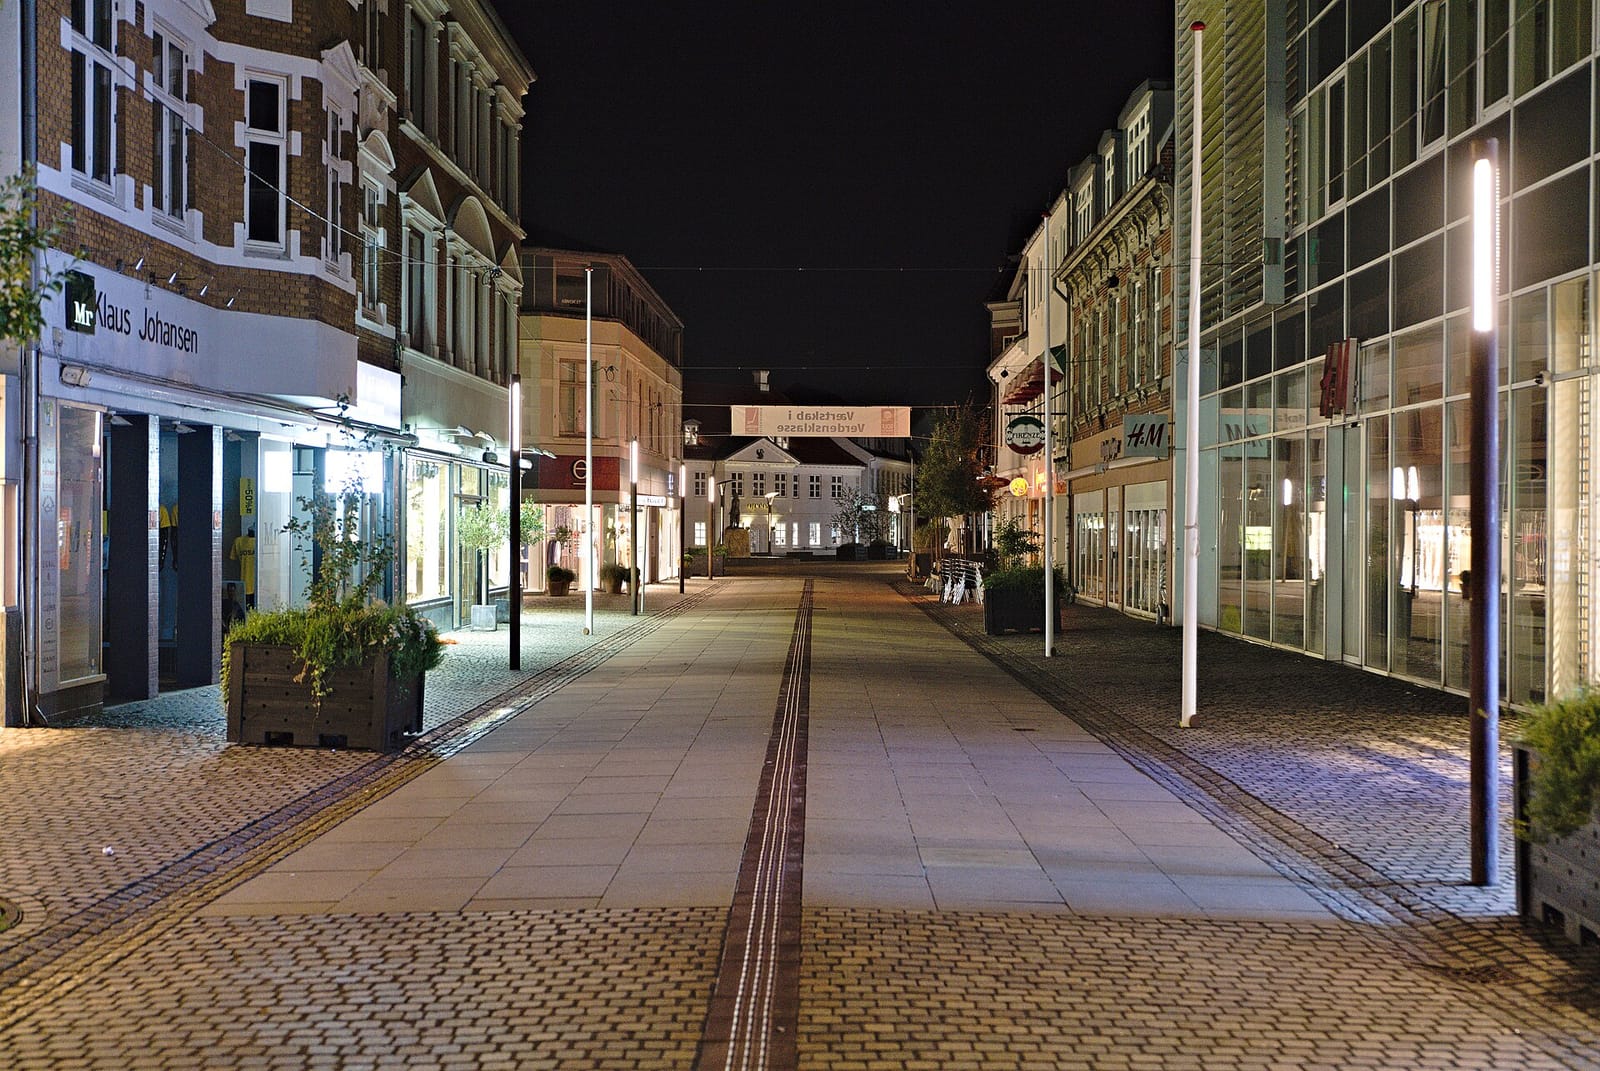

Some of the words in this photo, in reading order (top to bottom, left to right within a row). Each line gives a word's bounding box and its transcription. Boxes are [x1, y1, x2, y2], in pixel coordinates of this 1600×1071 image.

[74, 300, 94, 327] Mr
[95, 291, 131, 336] Klaus
[138, 307, 198, 354] Johansen
[1127, 422, 1165, 448] H&M
